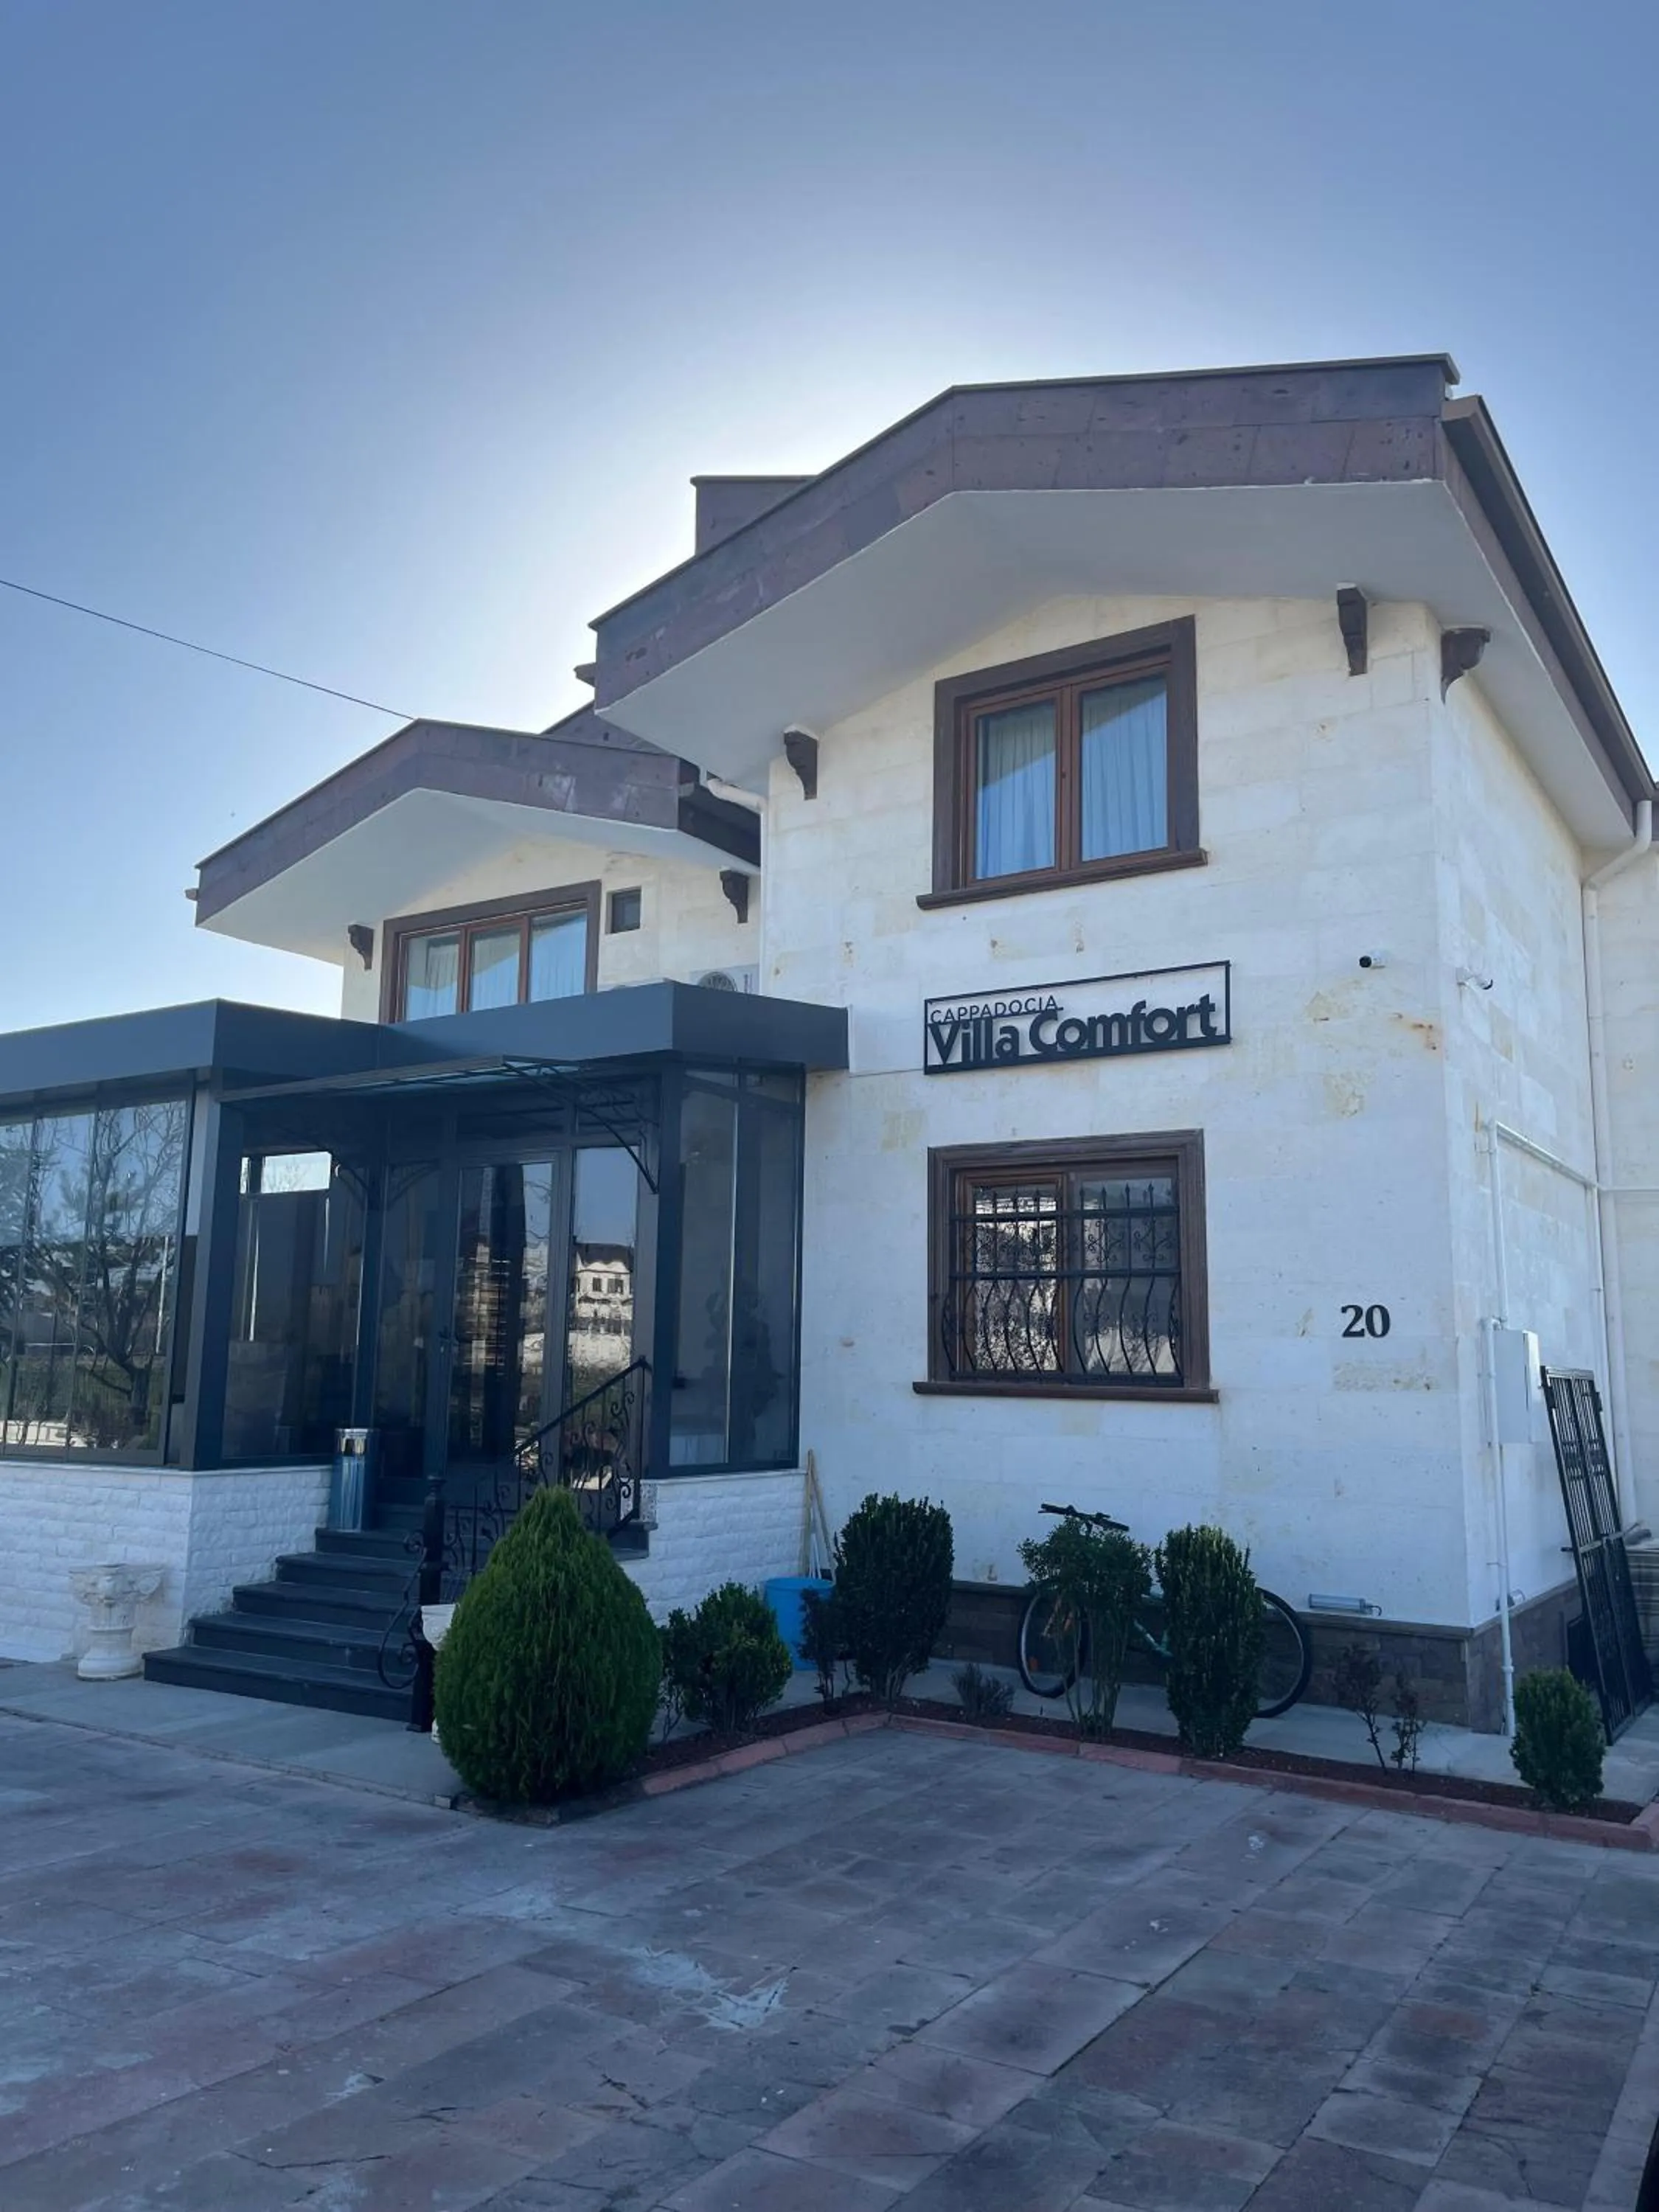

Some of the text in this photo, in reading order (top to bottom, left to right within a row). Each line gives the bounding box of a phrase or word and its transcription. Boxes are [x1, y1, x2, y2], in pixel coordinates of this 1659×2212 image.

[931, 995, 1059, 1023] CAPPADOCIA
[1029, 994, 1217, 1054] Comfort
[1340, 1304, 1391, 1338] 20
